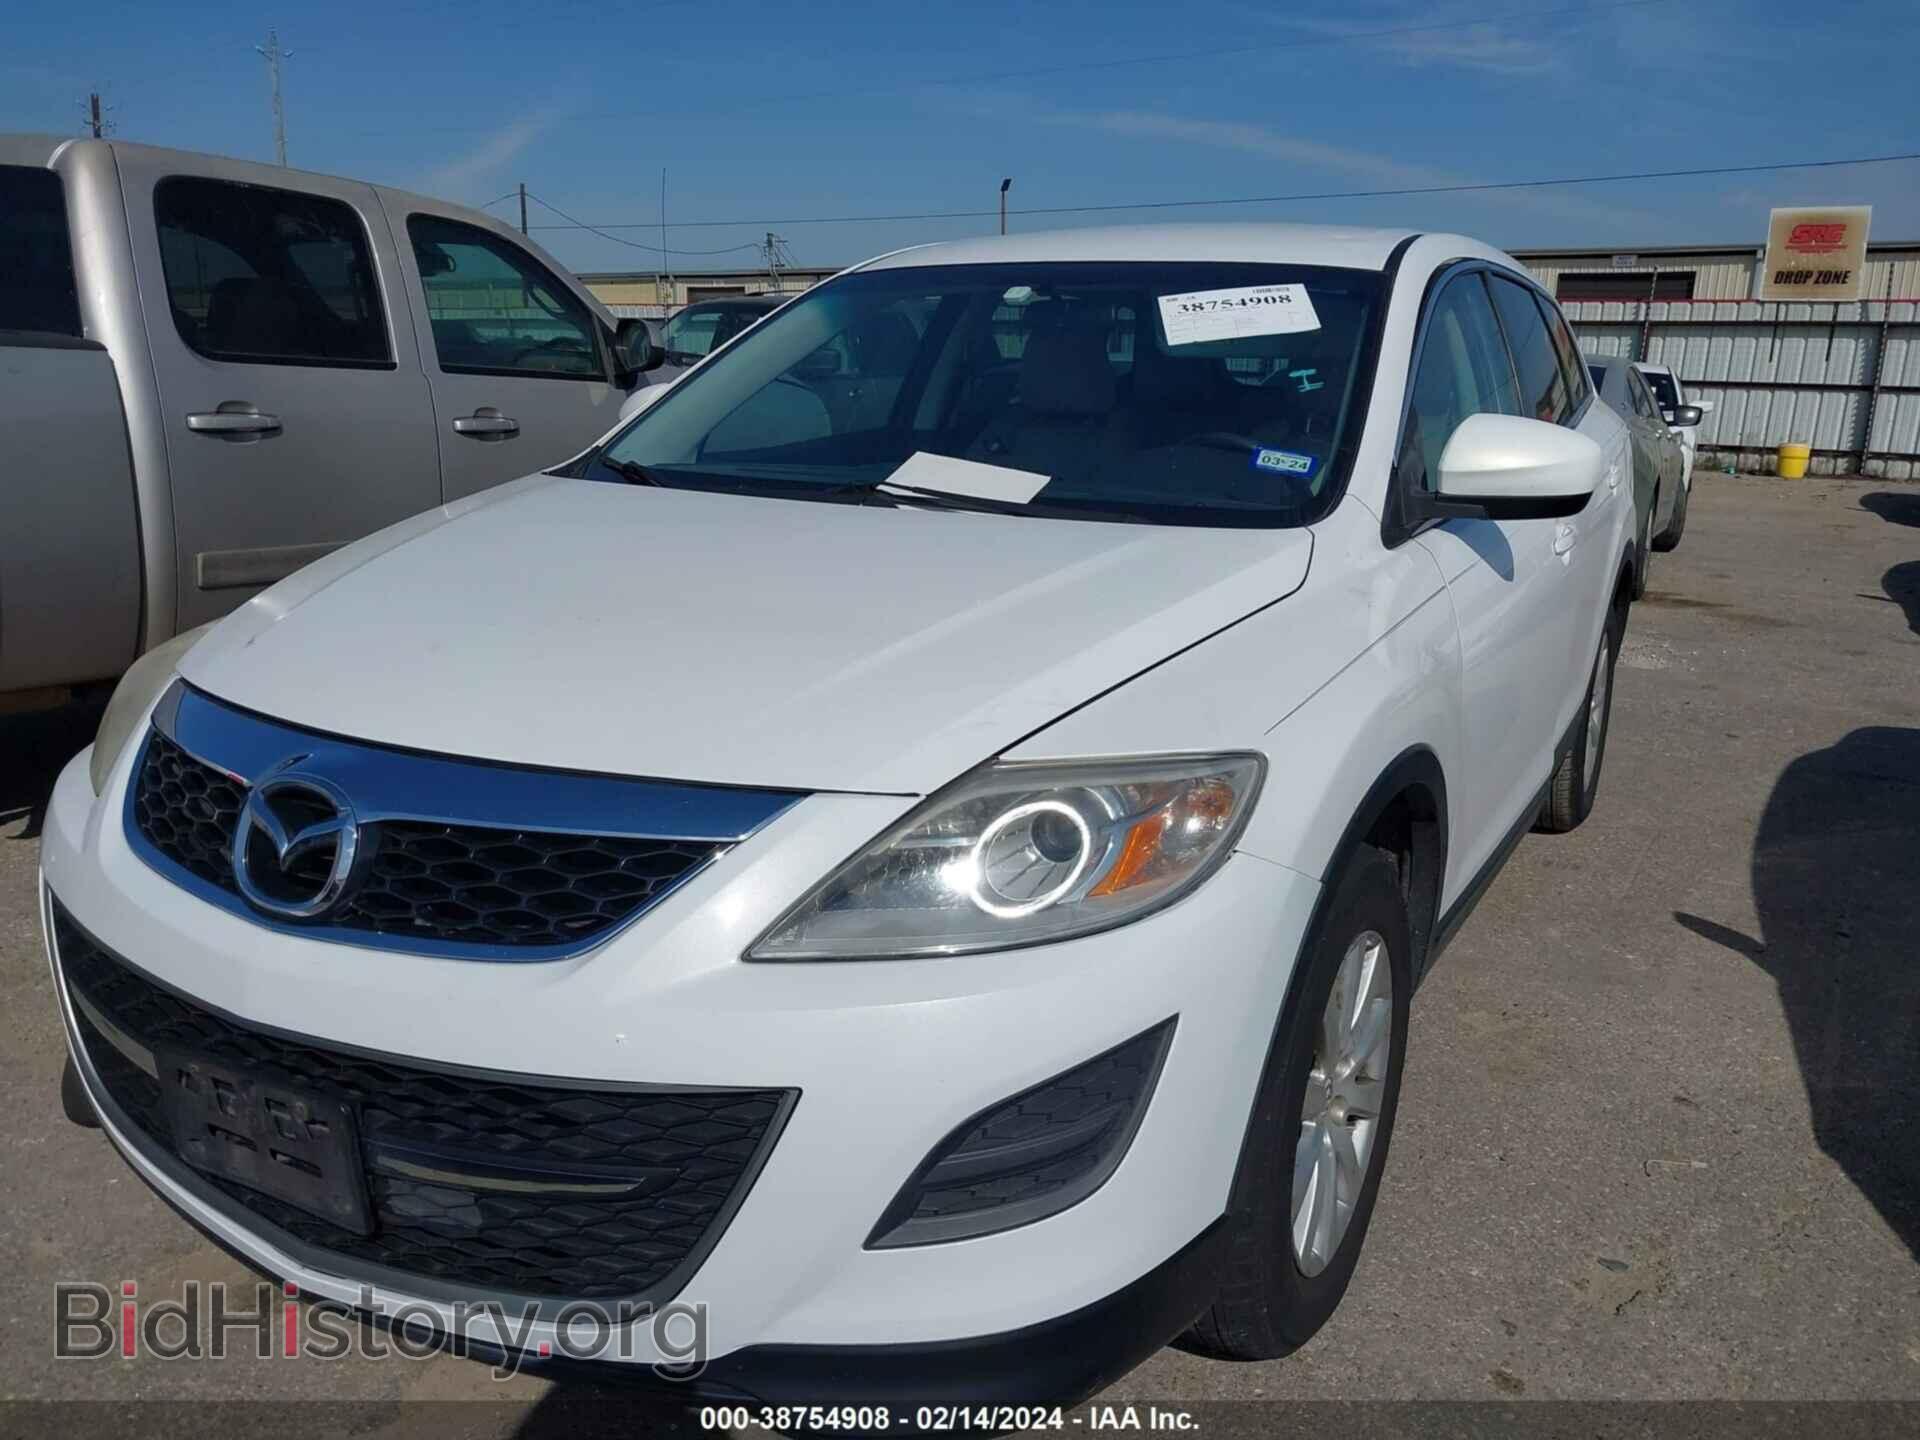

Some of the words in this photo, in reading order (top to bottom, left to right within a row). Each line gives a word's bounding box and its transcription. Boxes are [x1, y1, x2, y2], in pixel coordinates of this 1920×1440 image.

[1774, 270, 1813, 284] DROP
[1813, 270, 1851, 284] ZONE
[1177, 294, 1292, 313] 38754908
